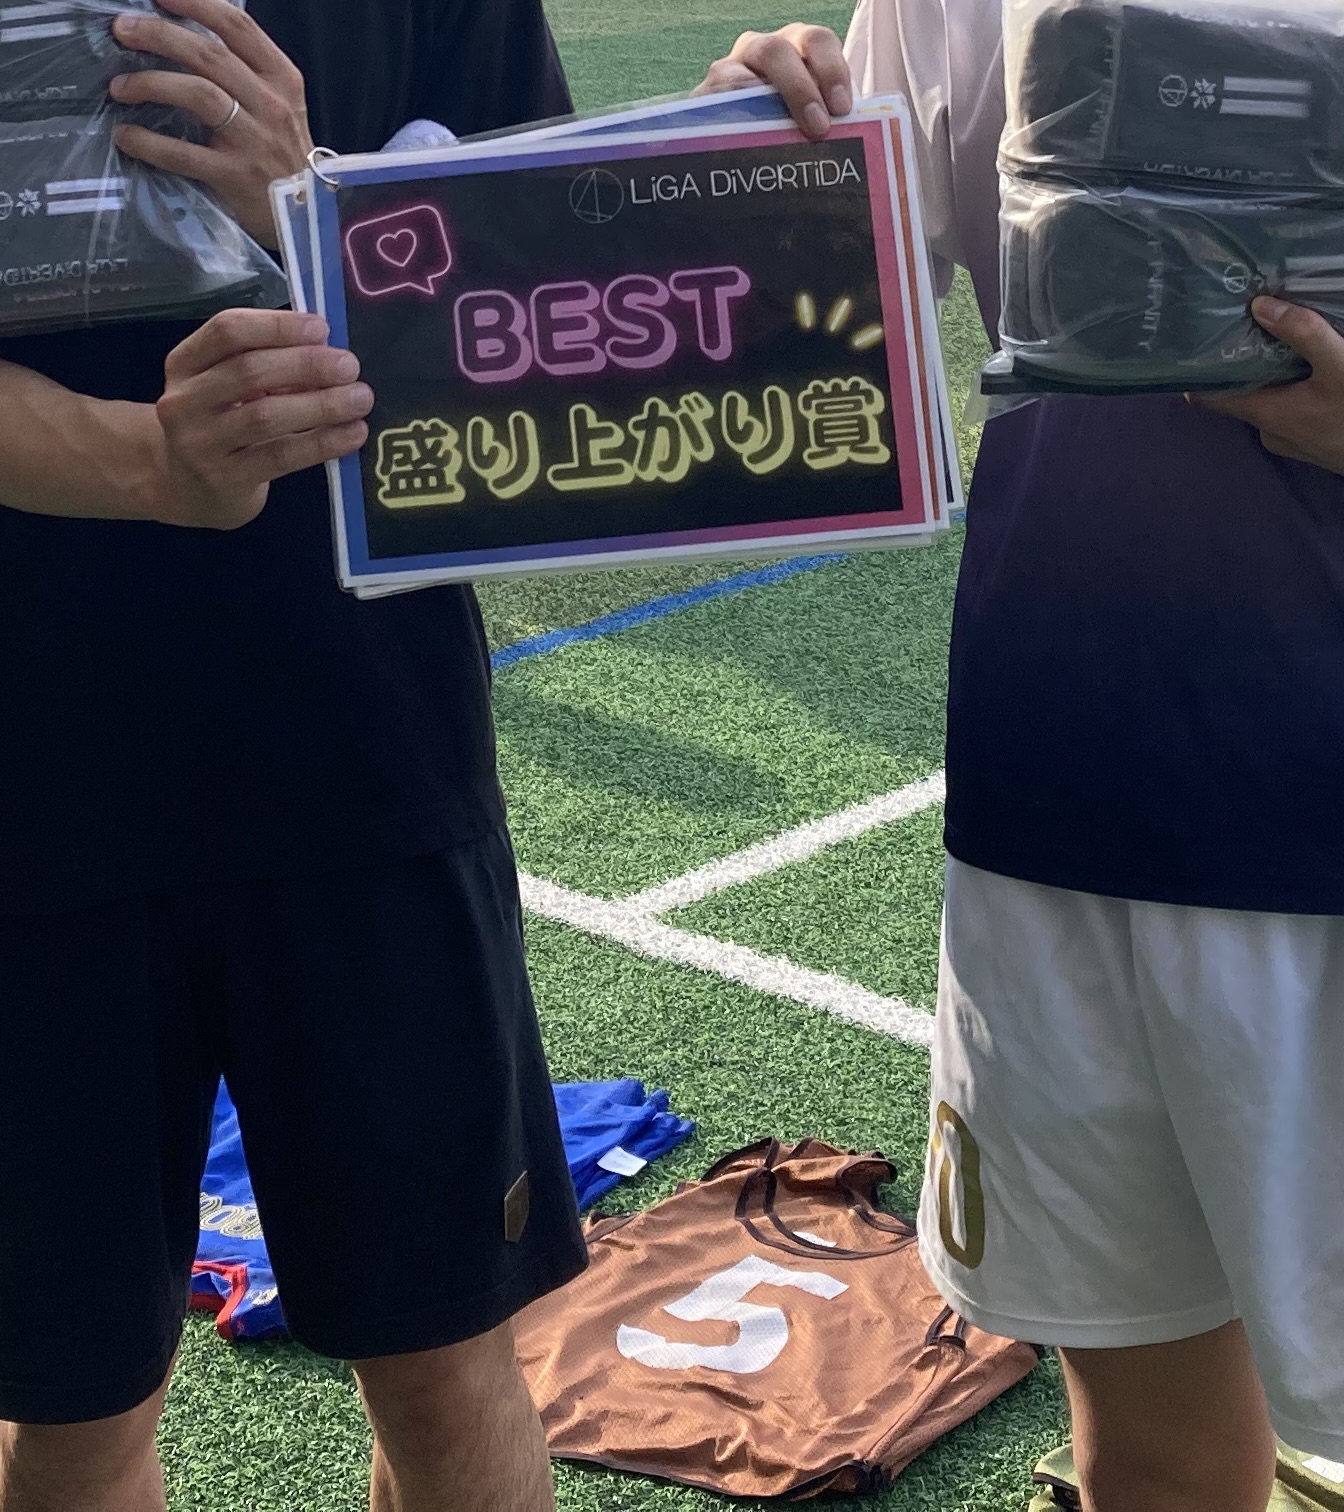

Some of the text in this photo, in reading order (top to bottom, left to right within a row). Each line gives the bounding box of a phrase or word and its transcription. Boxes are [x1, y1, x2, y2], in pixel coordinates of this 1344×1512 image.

[454, 265, 751, 383] BEST
[376, 375, 891, 509] 盛り上がり賞
[616, 1254, 850, 1374] 5
